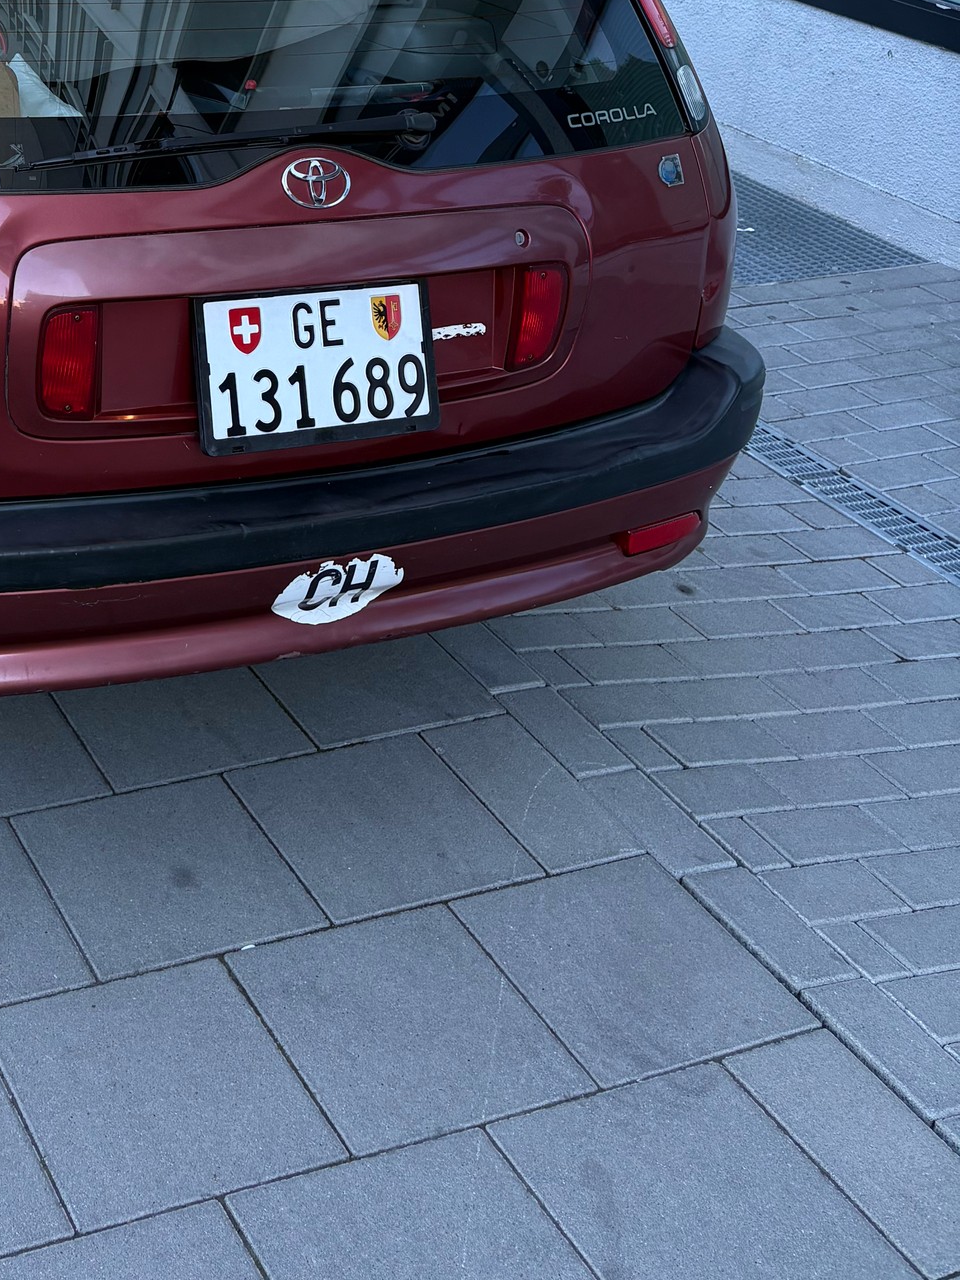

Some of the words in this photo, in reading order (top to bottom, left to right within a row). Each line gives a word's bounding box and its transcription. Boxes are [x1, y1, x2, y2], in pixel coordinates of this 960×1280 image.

[566, 102, 658, 129] COROLLA
[292, 299, 344, 349] GE
[297, 559, 379, 611] CH
